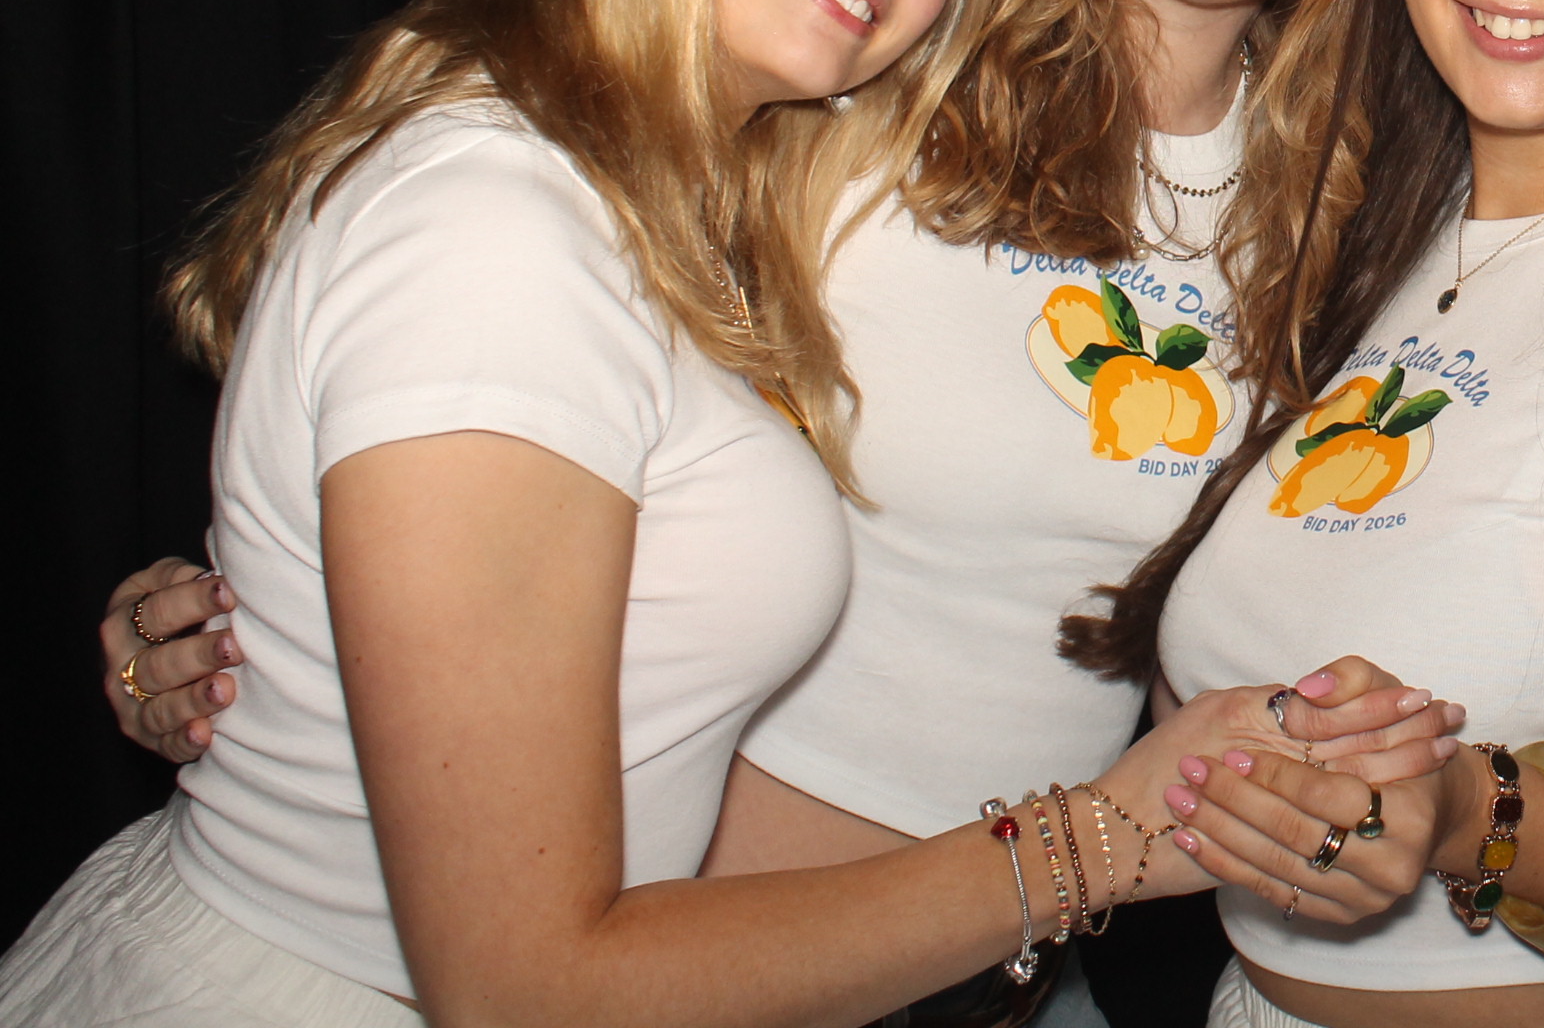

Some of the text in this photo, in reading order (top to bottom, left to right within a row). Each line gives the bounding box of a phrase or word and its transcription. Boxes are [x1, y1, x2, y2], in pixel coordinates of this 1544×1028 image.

[1175, 282, 1235, 342] Delt
[1390, 335, 1445, 373] Delta
[1440, 348, 1490, 407] Delta
[1138, 458, 1166, 476] BID
[1170, 460, 1199, 477] DAY
[1302, 512, 1407, 533] BID DAY 2026
